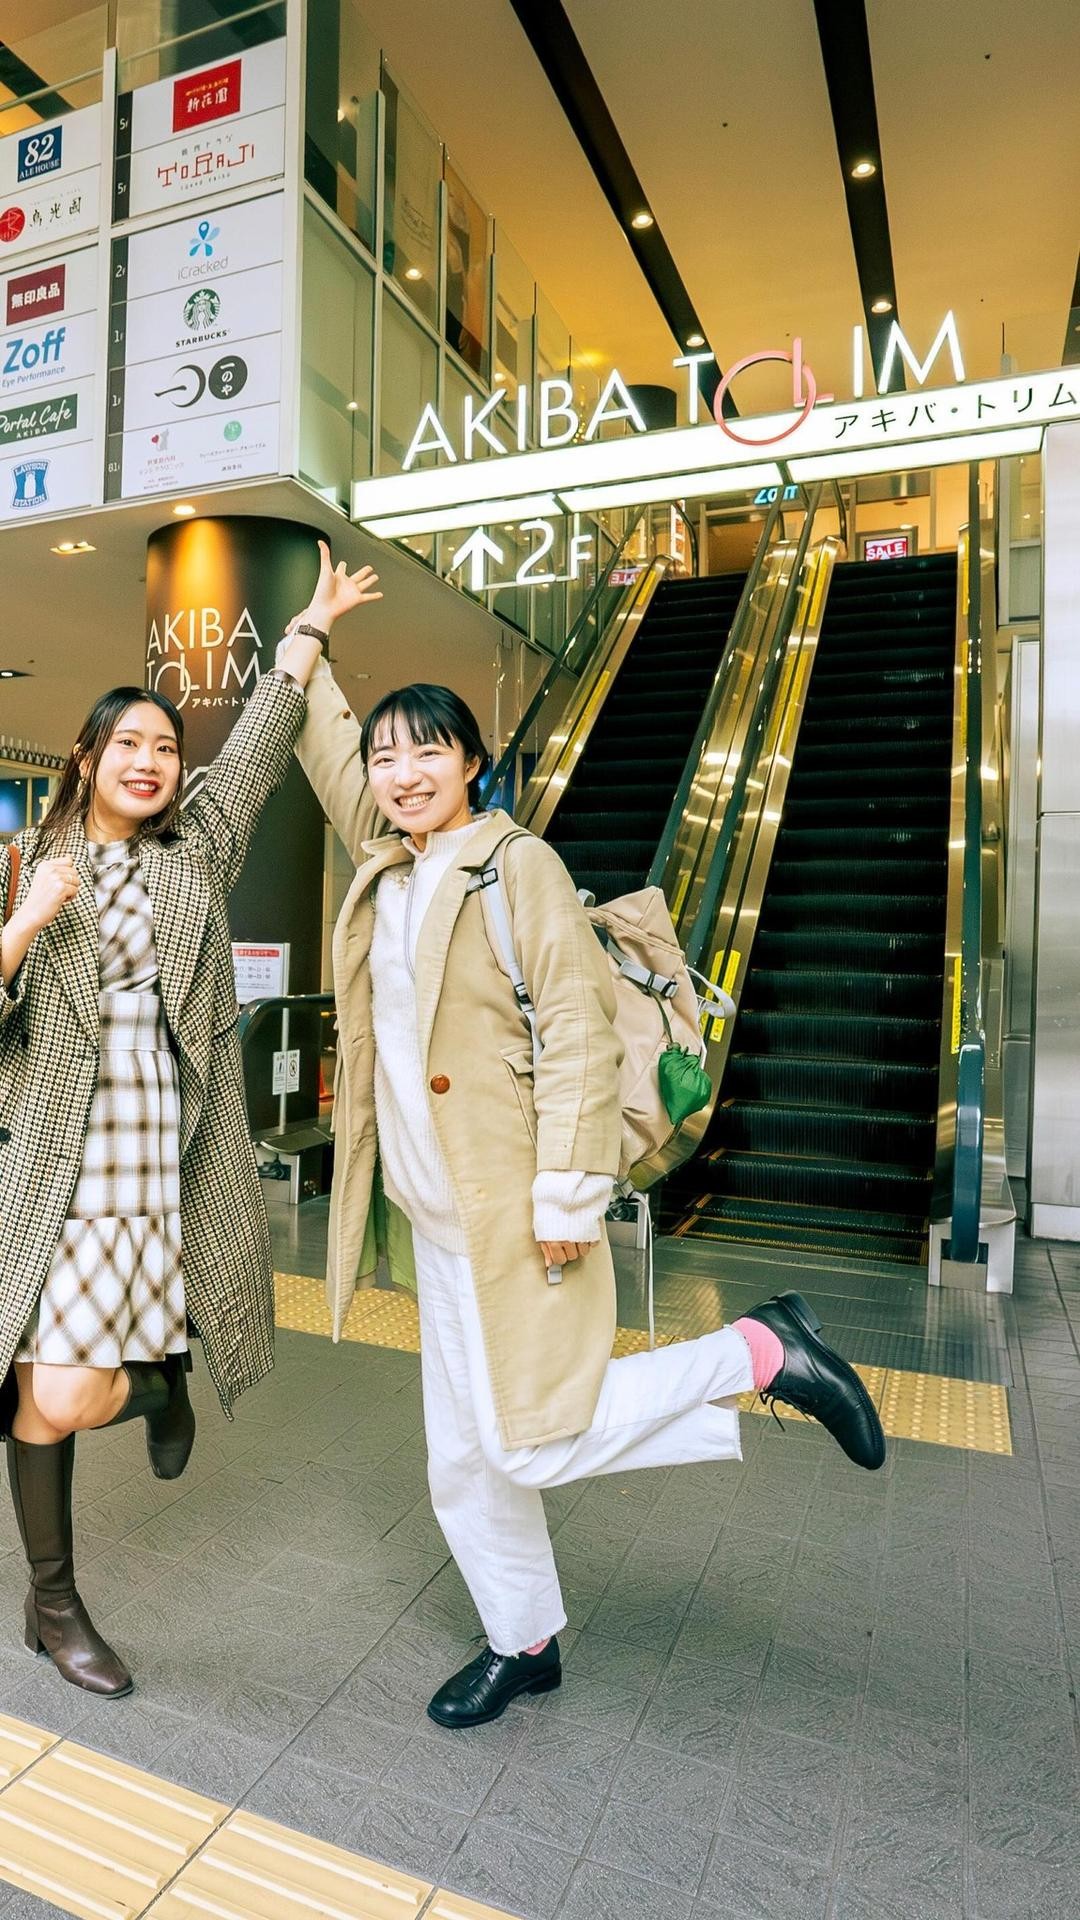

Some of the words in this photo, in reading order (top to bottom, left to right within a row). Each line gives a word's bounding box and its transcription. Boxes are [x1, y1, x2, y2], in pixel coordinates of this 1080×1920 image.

[25, 133, 55, 167] 82
[158, 143, 254, 187] TORAJI
[19, 167, 35, 179] ALE
[35, 158, 61, 175] HOUSE
[178, 256, 229, 280] iCracked
[11, 282, 60, 309] 無印良品
[3, 326, 66, 374] Zoff
[176, 331, 228, 347] STARBUCKS
[2, 378, 15, 388] Eye
[17, 365, 66, 384] Performance
[220, 362, 236, 396] 一のや
[39, 399, 72, 430] Cafe
[402, 368, 647, 471] AKIBA
[834, 383, 1077, 438] アキバ・トリム
[16, 428, 47, 439] AKIBA
[14, 462, 48, 476] LAWSON
[516, 518, 592, 585] 2F
[866, 544, 904, 560] SALE
[147, 607, 263, 659] AKIBA
